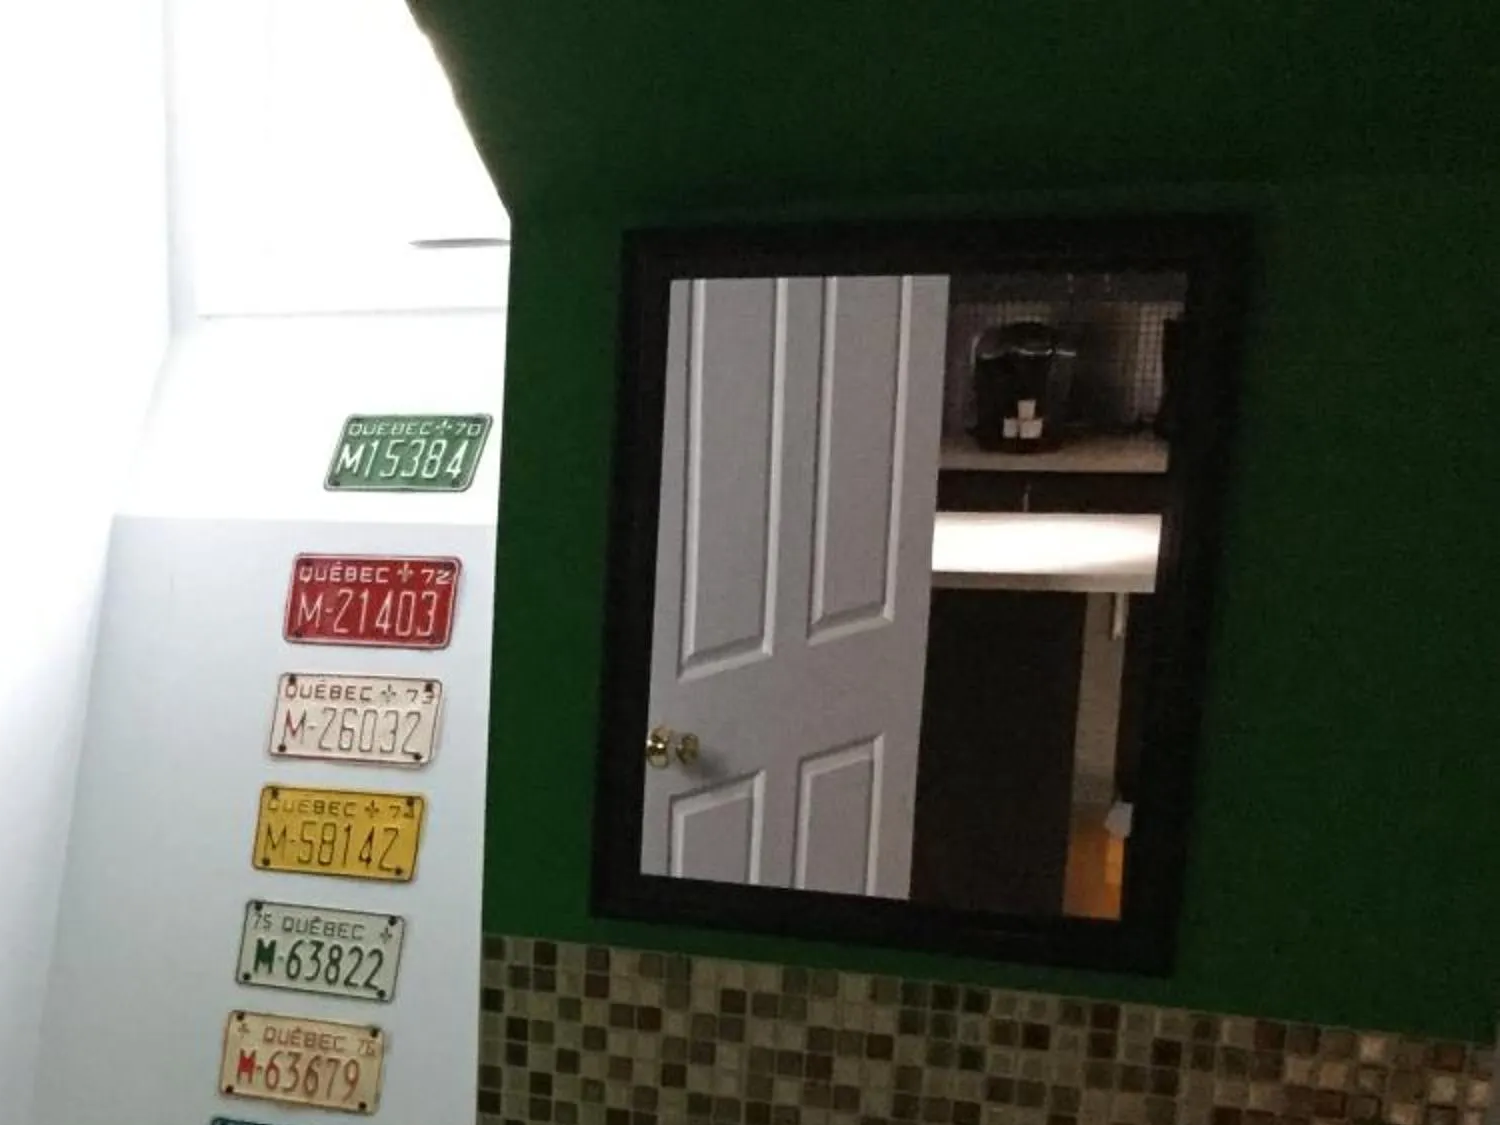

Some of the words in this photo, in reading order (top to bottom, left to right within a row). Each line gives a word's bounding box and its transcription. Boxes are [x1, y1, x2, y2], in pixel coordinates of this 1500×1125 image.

[420, 569, 452, 585] 72
[298, 587, 438, 637] M-21403
[282, 707, 421, 755] M-26032
[253, 913, 272, 931] 75
[253, 937, 384, 991] M-63822
[236, 1048, 360, 1103] M-63679
